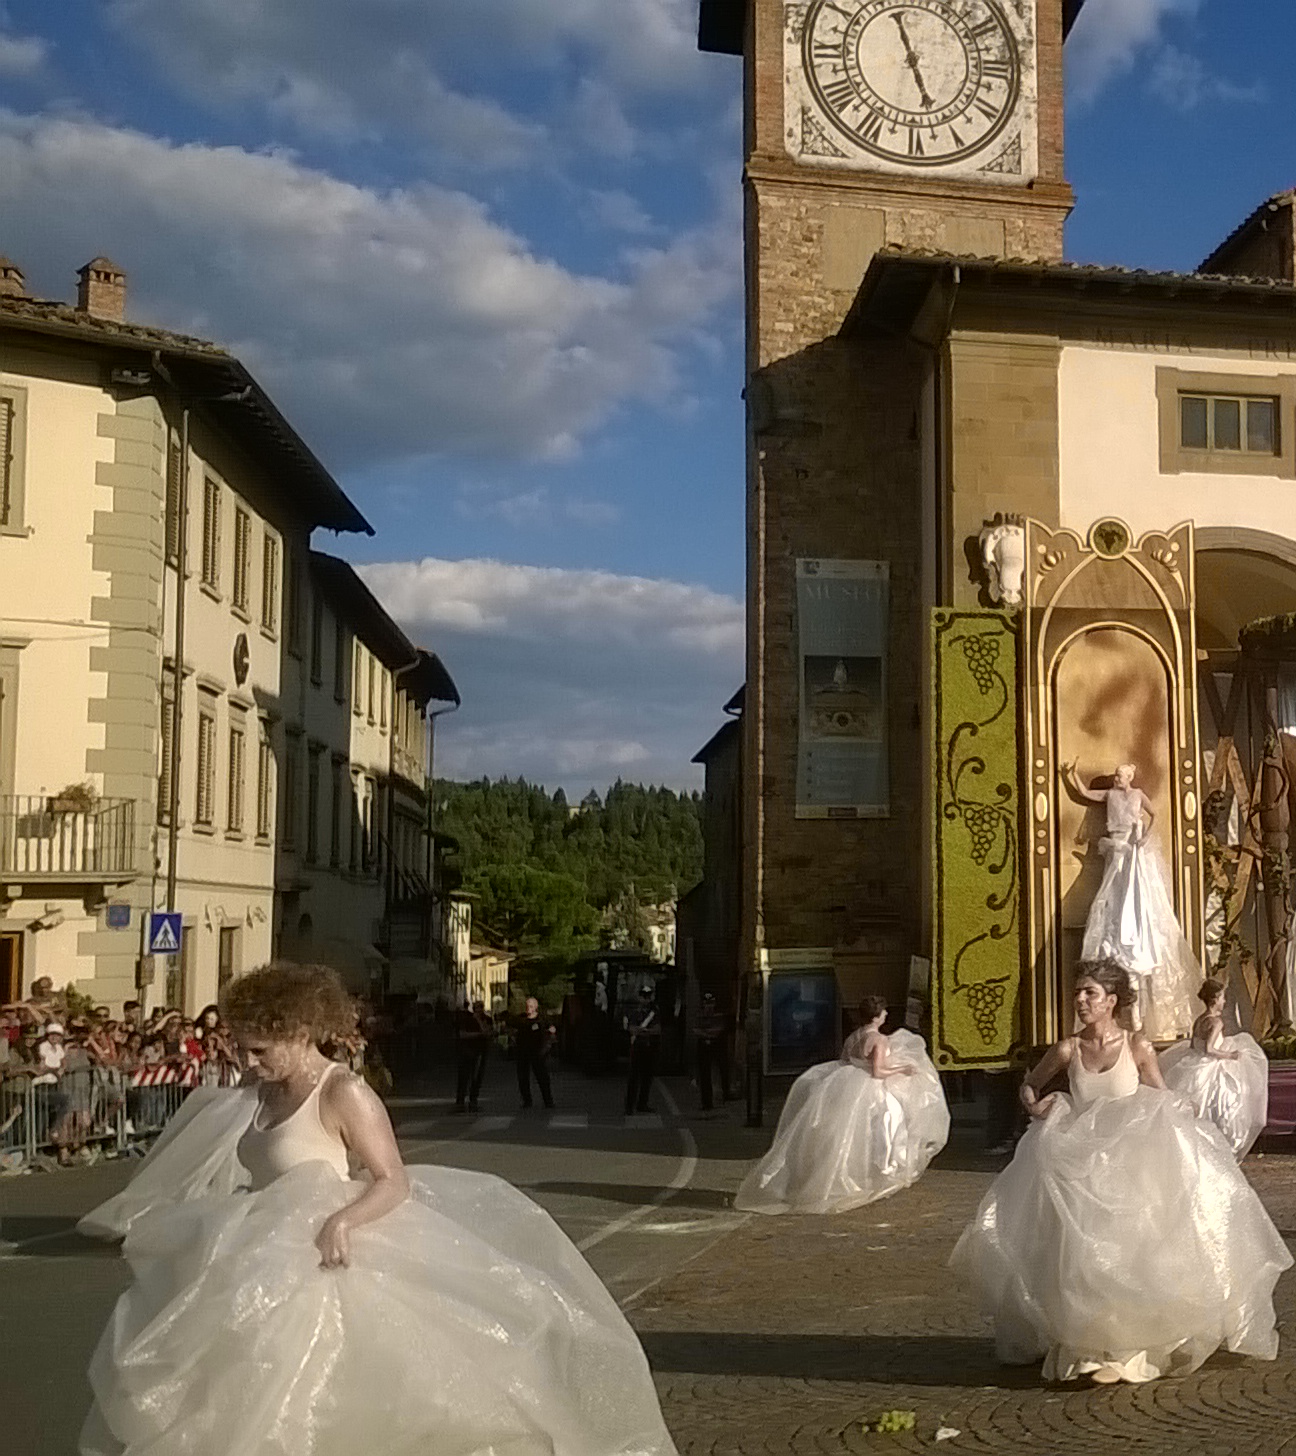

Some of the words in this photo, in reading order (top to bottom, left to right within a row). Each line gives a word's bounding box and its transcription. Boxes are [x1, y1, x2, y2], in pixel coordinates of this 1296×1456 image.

[982, 60, 1009, 79] III
[821, 79, 857, 114] VIII
[855, 110, 884, 144] VII
[908, 127, 925, 156] VI
[948, 123, 966, 148] V
